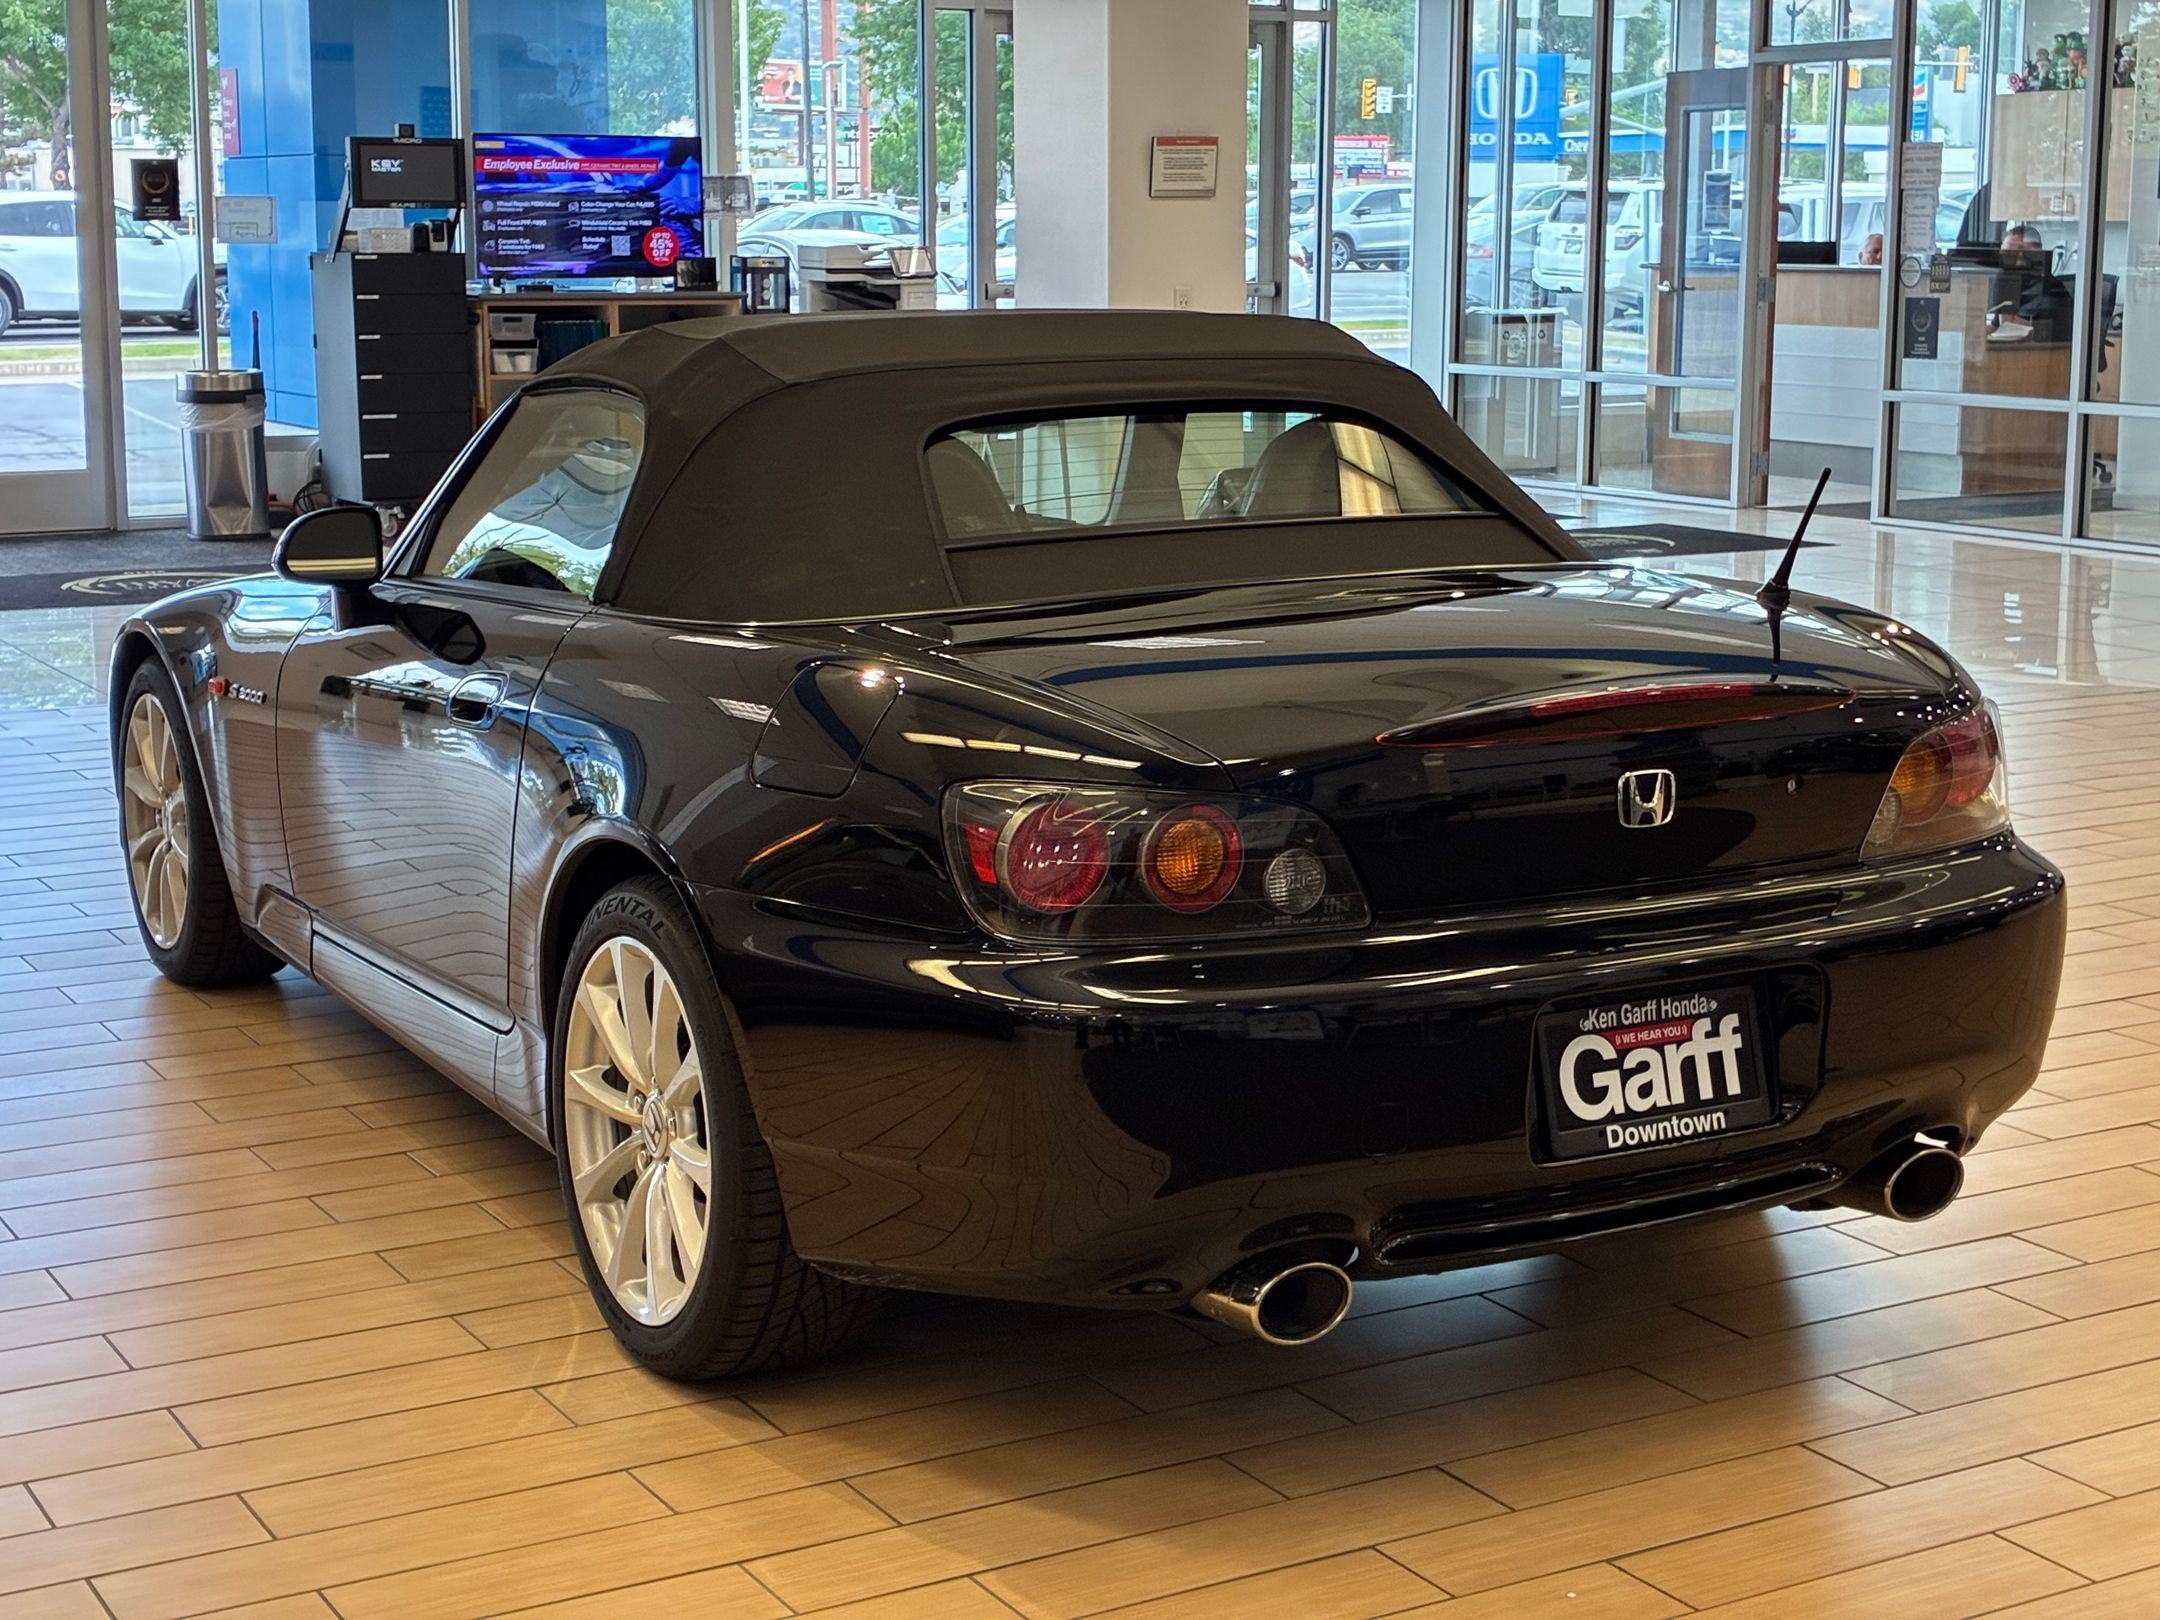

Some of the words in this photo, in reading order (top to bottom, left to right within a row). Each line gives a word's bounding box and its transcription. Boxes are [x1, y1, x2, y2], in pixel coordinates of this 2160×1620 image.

[1470, 132, 1552, 145] HODA
[483, 158, 533, 171] Employee
[533, 158, 580, 170] Exclusive
[649, 239, 674, 248] 45%
[228, 683, 263, 704] S2000
[1588, 1008, 1617, 1031] Ken
[1620, 1001, 1657, 1025] Garff
[1661, 993, 1708, 1019] Honda
[1621, 1033, 1637, 1044] WE
[1637, 1030, 1662, 1042] HEAR
[1662, 1028, 1681, 1039] YOU
[1559, 1013, 1742, 1121] Garff
[1606, 1110, 1726, 1149] Downtown
